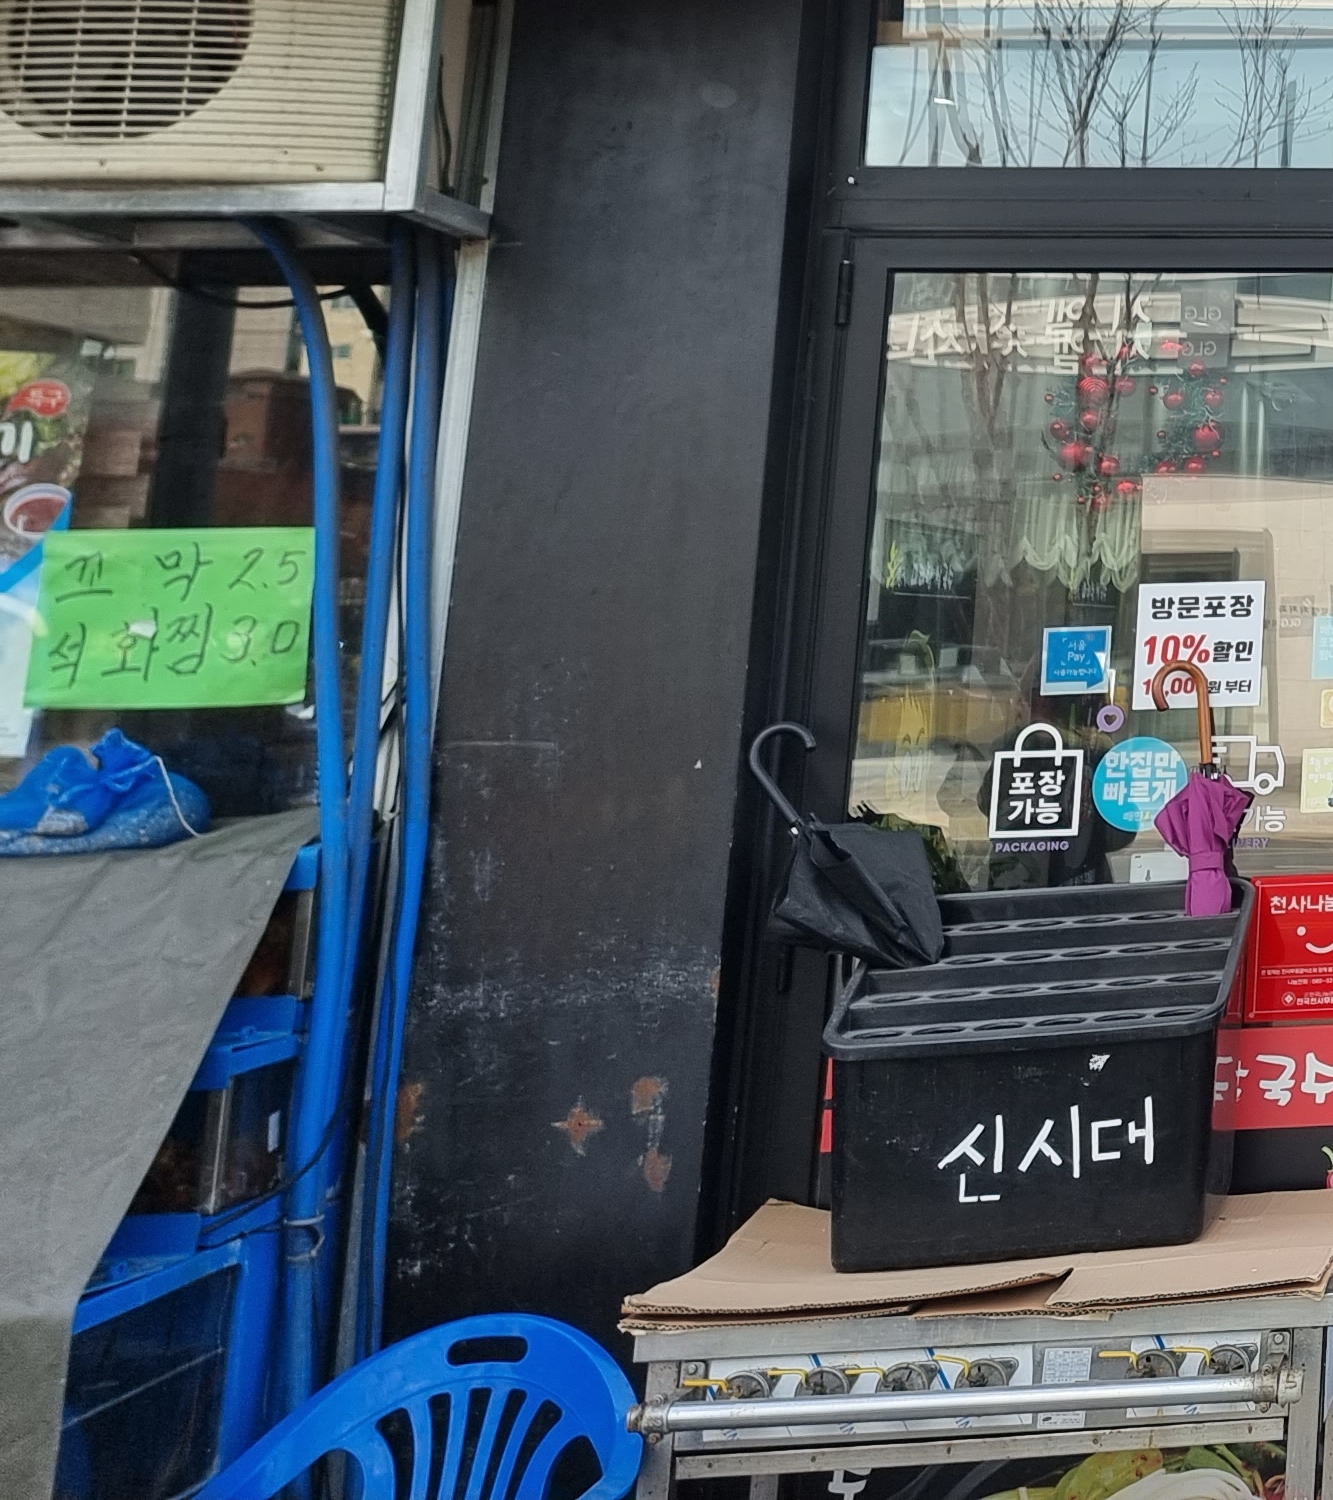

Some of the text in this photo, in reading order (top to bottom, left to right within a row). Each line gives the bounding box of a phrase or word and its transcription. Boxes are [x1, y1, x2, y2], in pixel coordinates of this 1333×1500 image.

[228, 547, 306, 591] 2.5
[1151, 595, 1254, 619] 방문포장
[1067, 651, 1085, 663] Pay
[1225, 680, 1252, 693] 부터
[1105, 750, 1181, 778] 한집만
[1008, 770, 1066, 796] 포장
[1007, 799, 1063, 825] 가능
[995, 841, 1070, 854] PACKAGING
[938, 1096, 1154, 1203] 신시대
